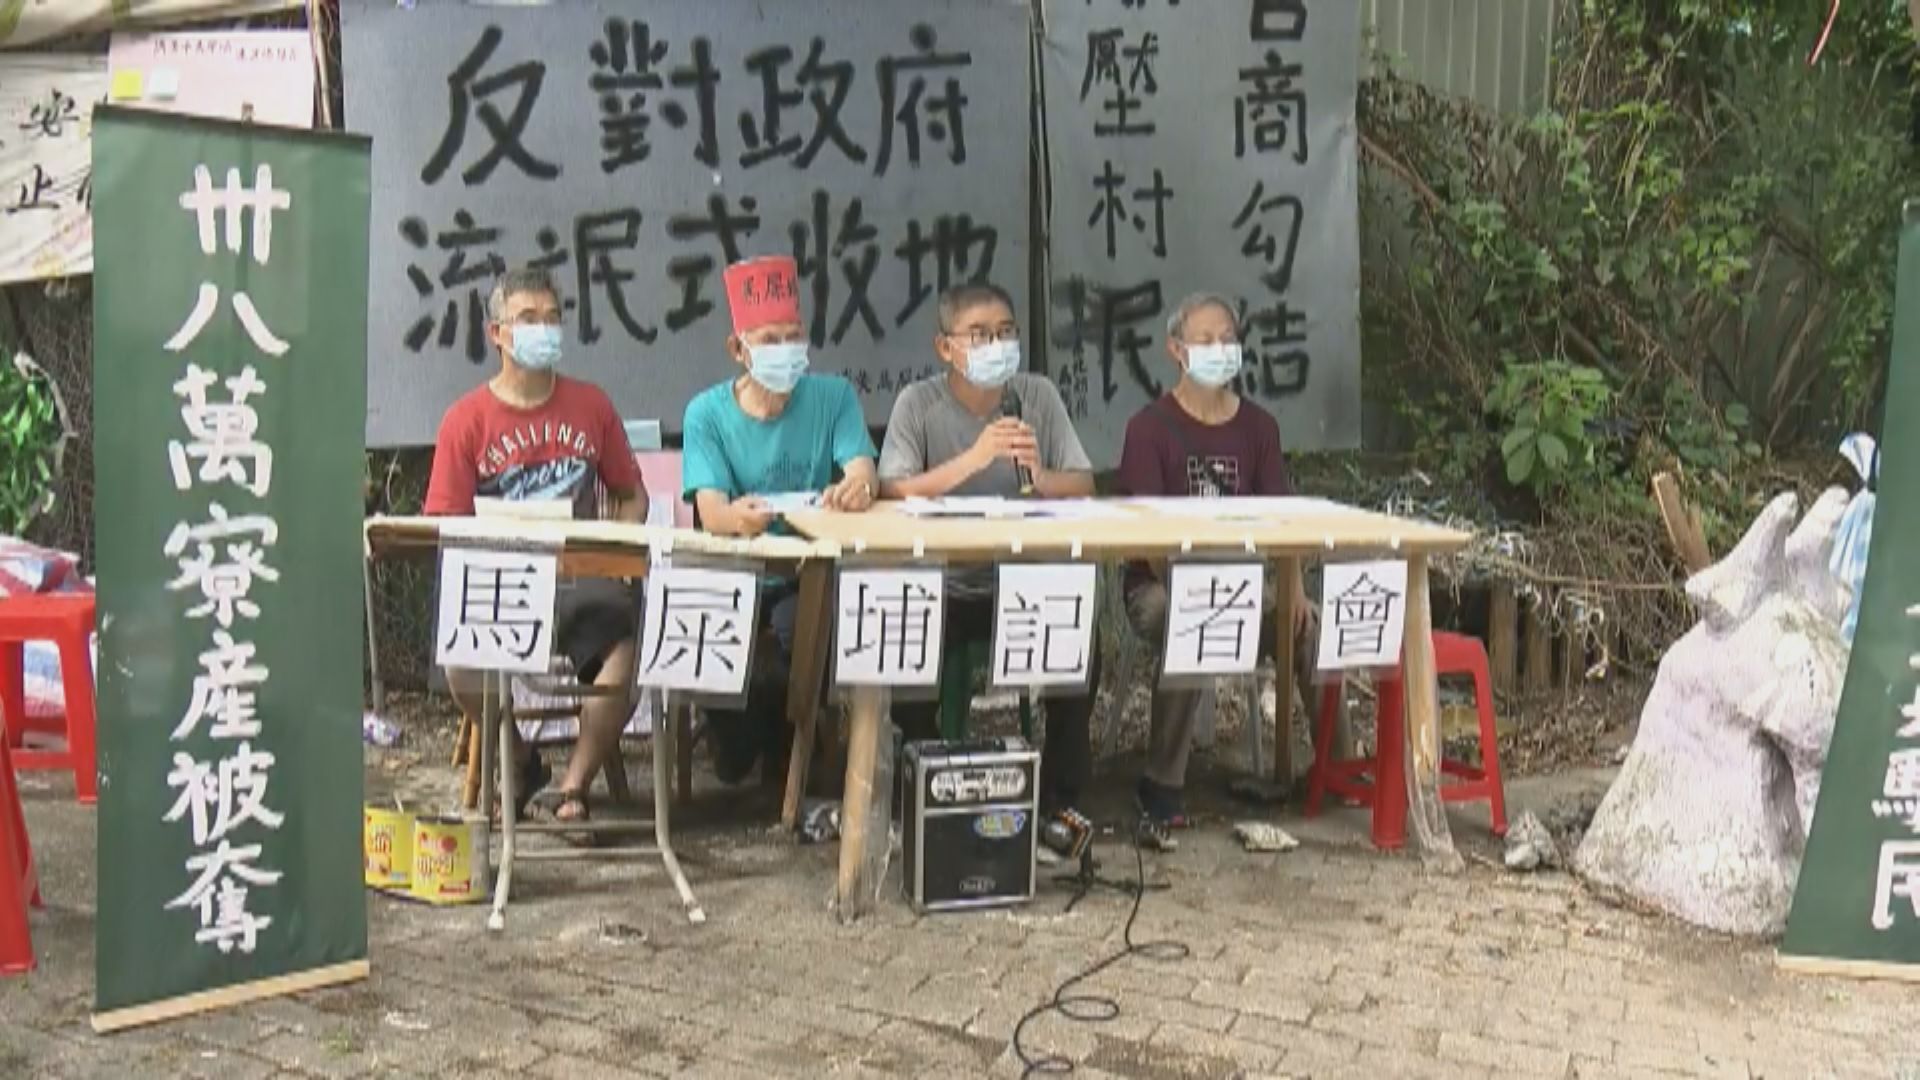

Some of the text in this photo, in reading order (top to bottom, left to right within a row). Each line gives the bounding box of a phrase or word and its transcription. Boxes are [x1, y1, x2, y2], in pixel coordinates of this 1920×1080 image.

[421, 18, 972, 185] 反對政府
[398, 188, 1000, 365] 流氓式收地
[445, 562, 1400, 678] 馬 屎 埔 記 者 會
